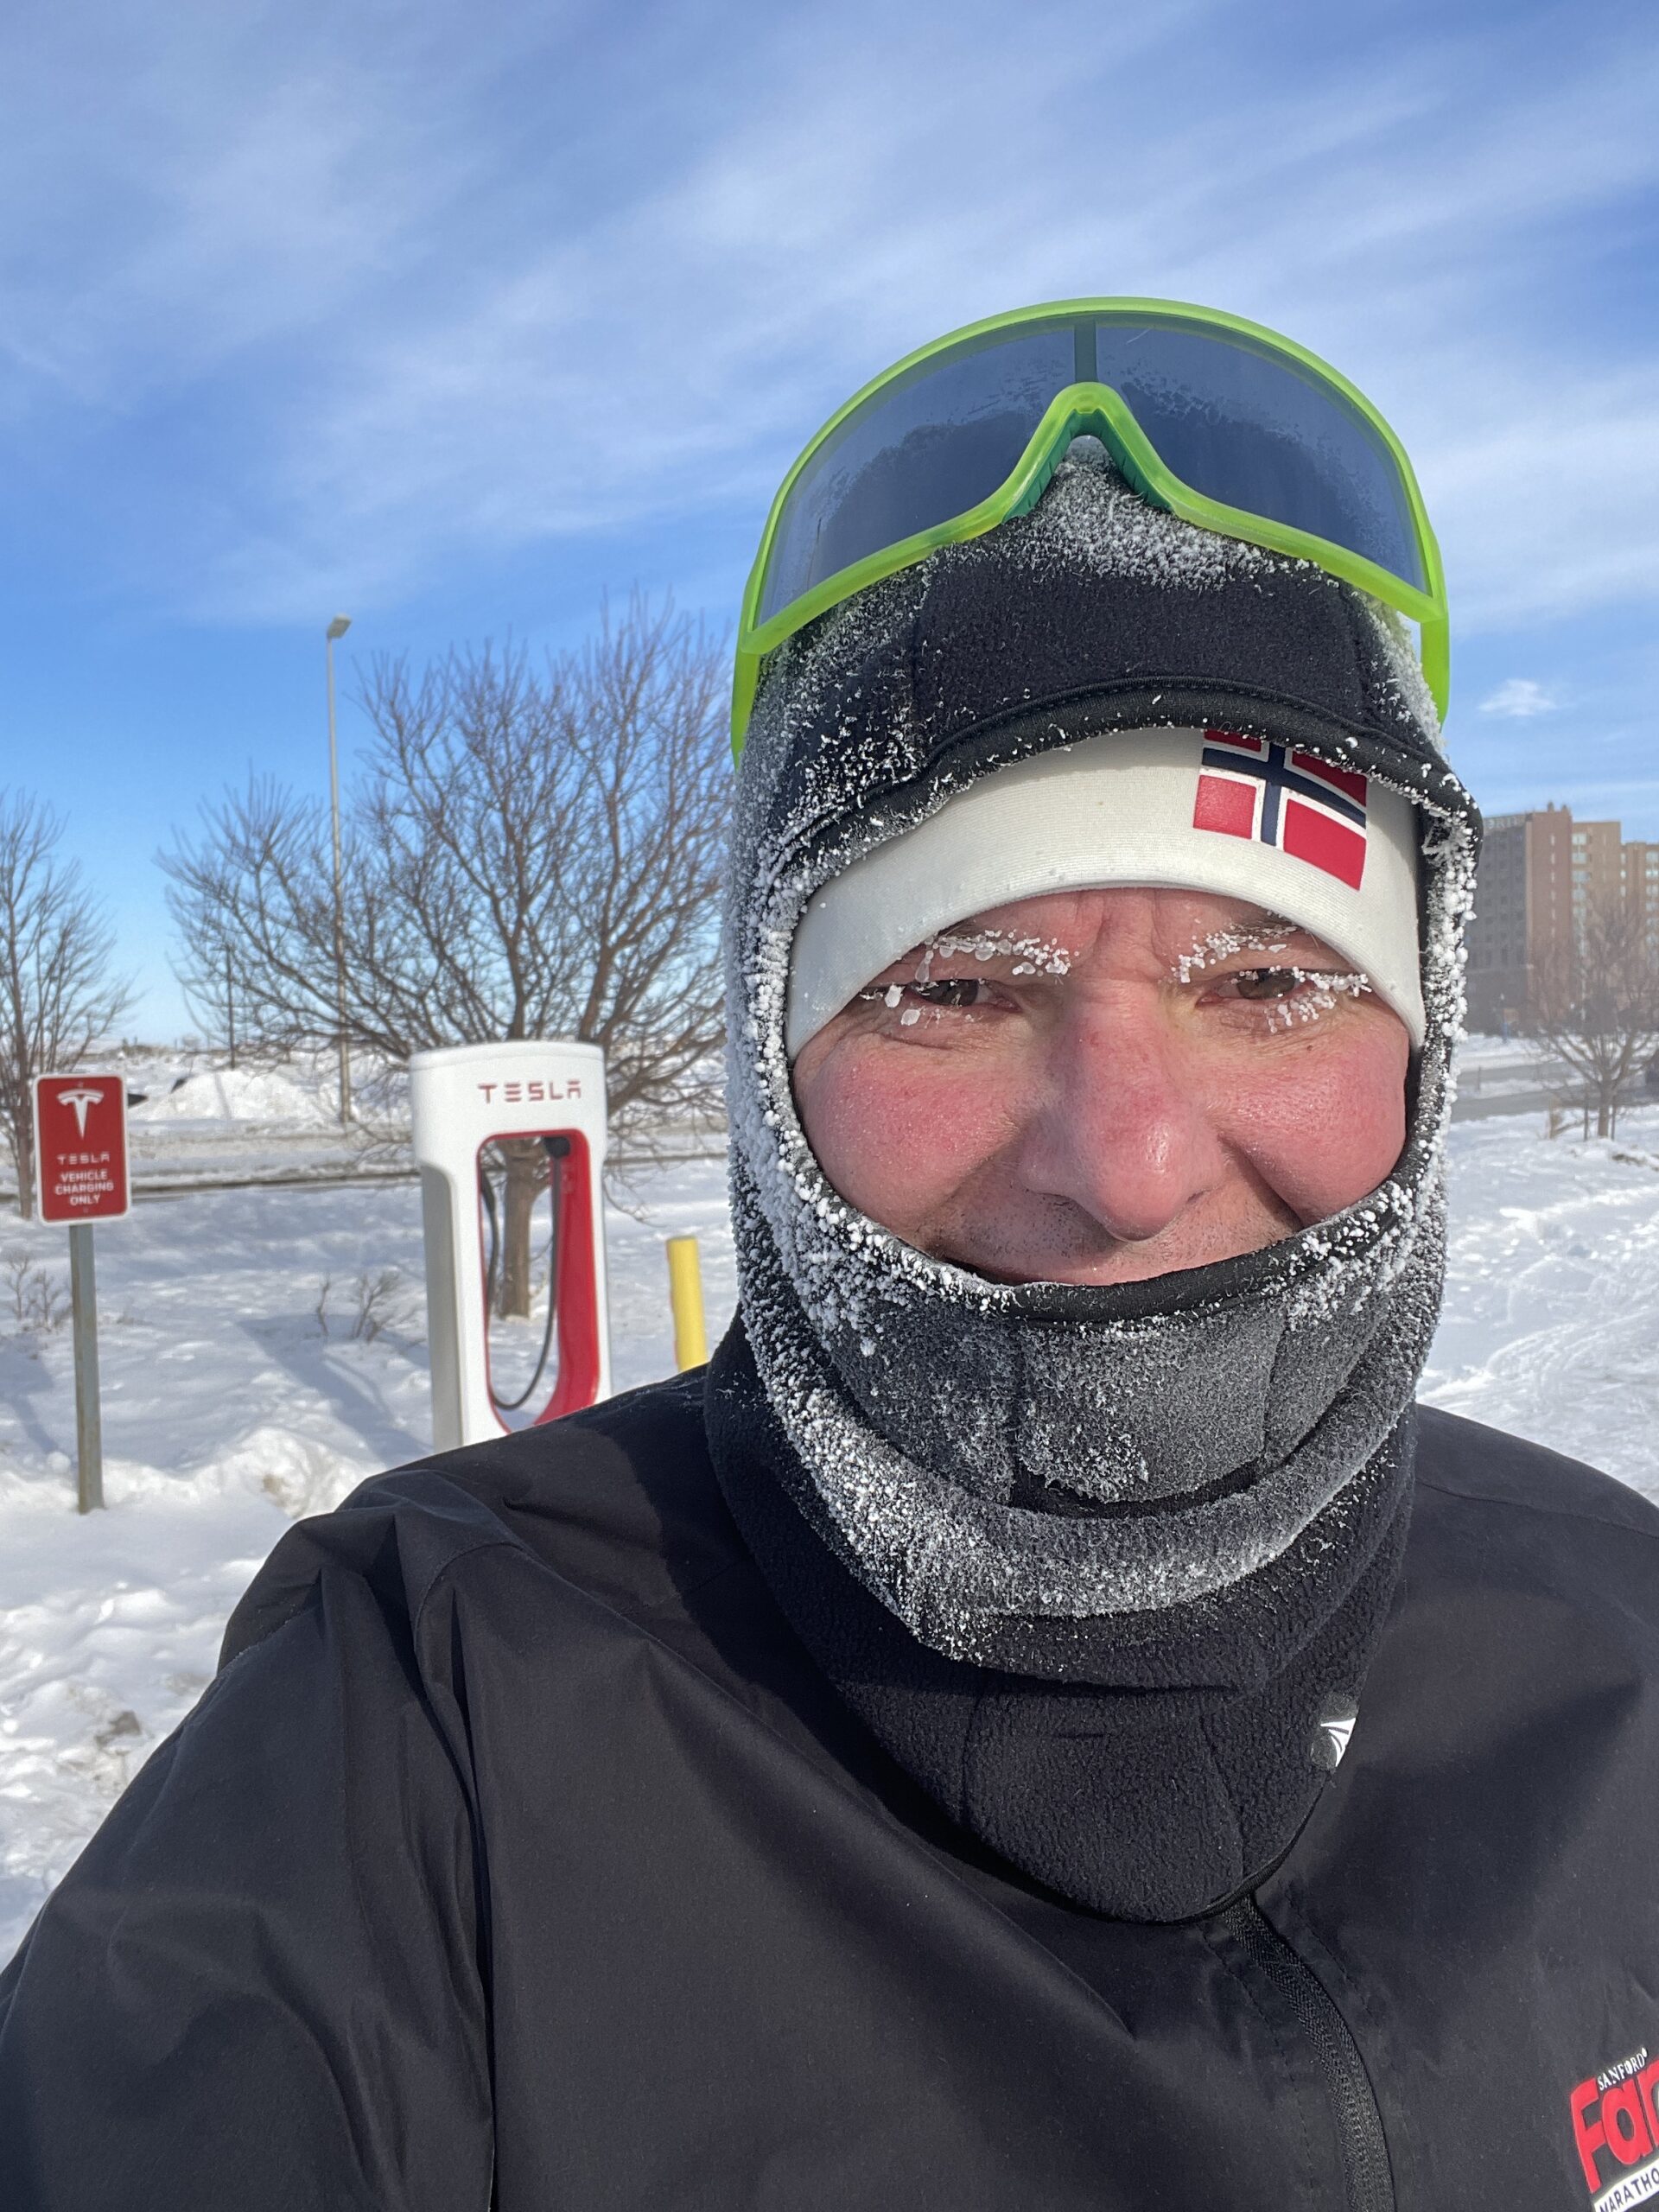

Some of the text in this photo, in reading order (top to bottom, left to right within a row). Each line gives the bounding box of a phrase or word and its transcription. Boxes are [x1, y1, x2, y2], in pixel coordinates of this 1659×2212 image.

[478, 1079, 581, 1103] TESLA
[57, 1152, 110, 1165] TESLA
[60, 1169, 107, 1182] VEHICLE
[54, 1181, 114, 1195] CHARGING
[70, 1194, 100, 1205] ONLY
[1598, 2052, 1645, 2091] SANFORD
